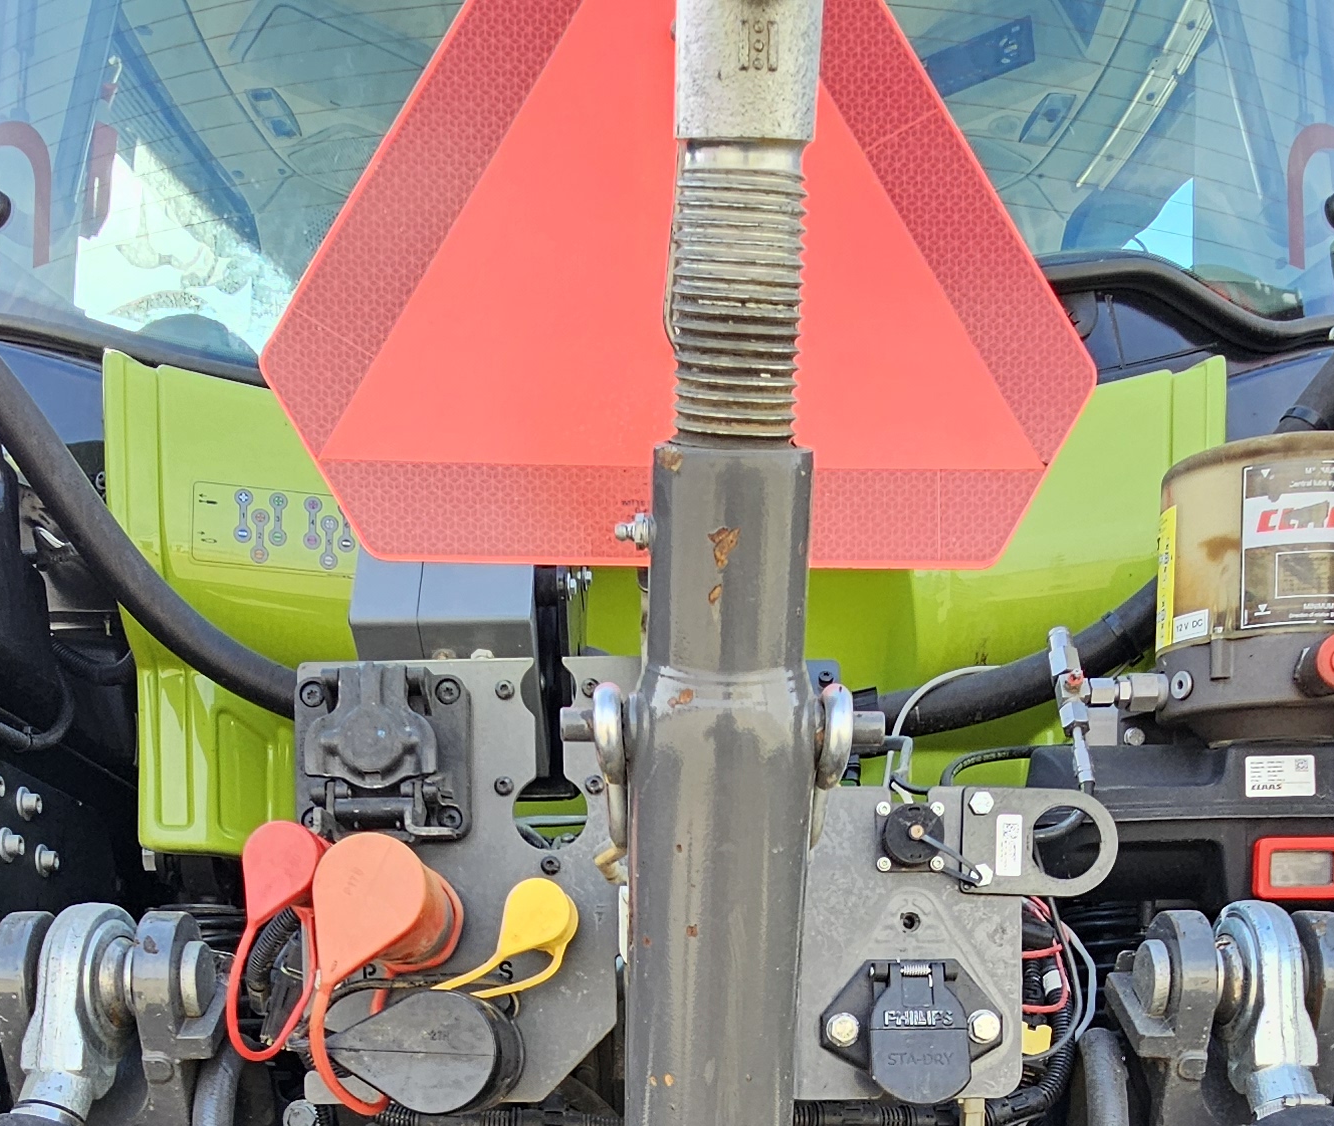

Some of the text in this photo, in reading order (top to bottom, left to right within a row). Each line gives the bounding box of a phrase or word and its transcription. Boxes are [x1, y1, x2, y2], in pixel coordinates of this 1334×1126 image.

[1192, 618, 1203, 628] DC
[362, 963, 377, 980] P
[499, 960, 514, 980] S
[888, 1052, 954, 1065] STA-DRY
